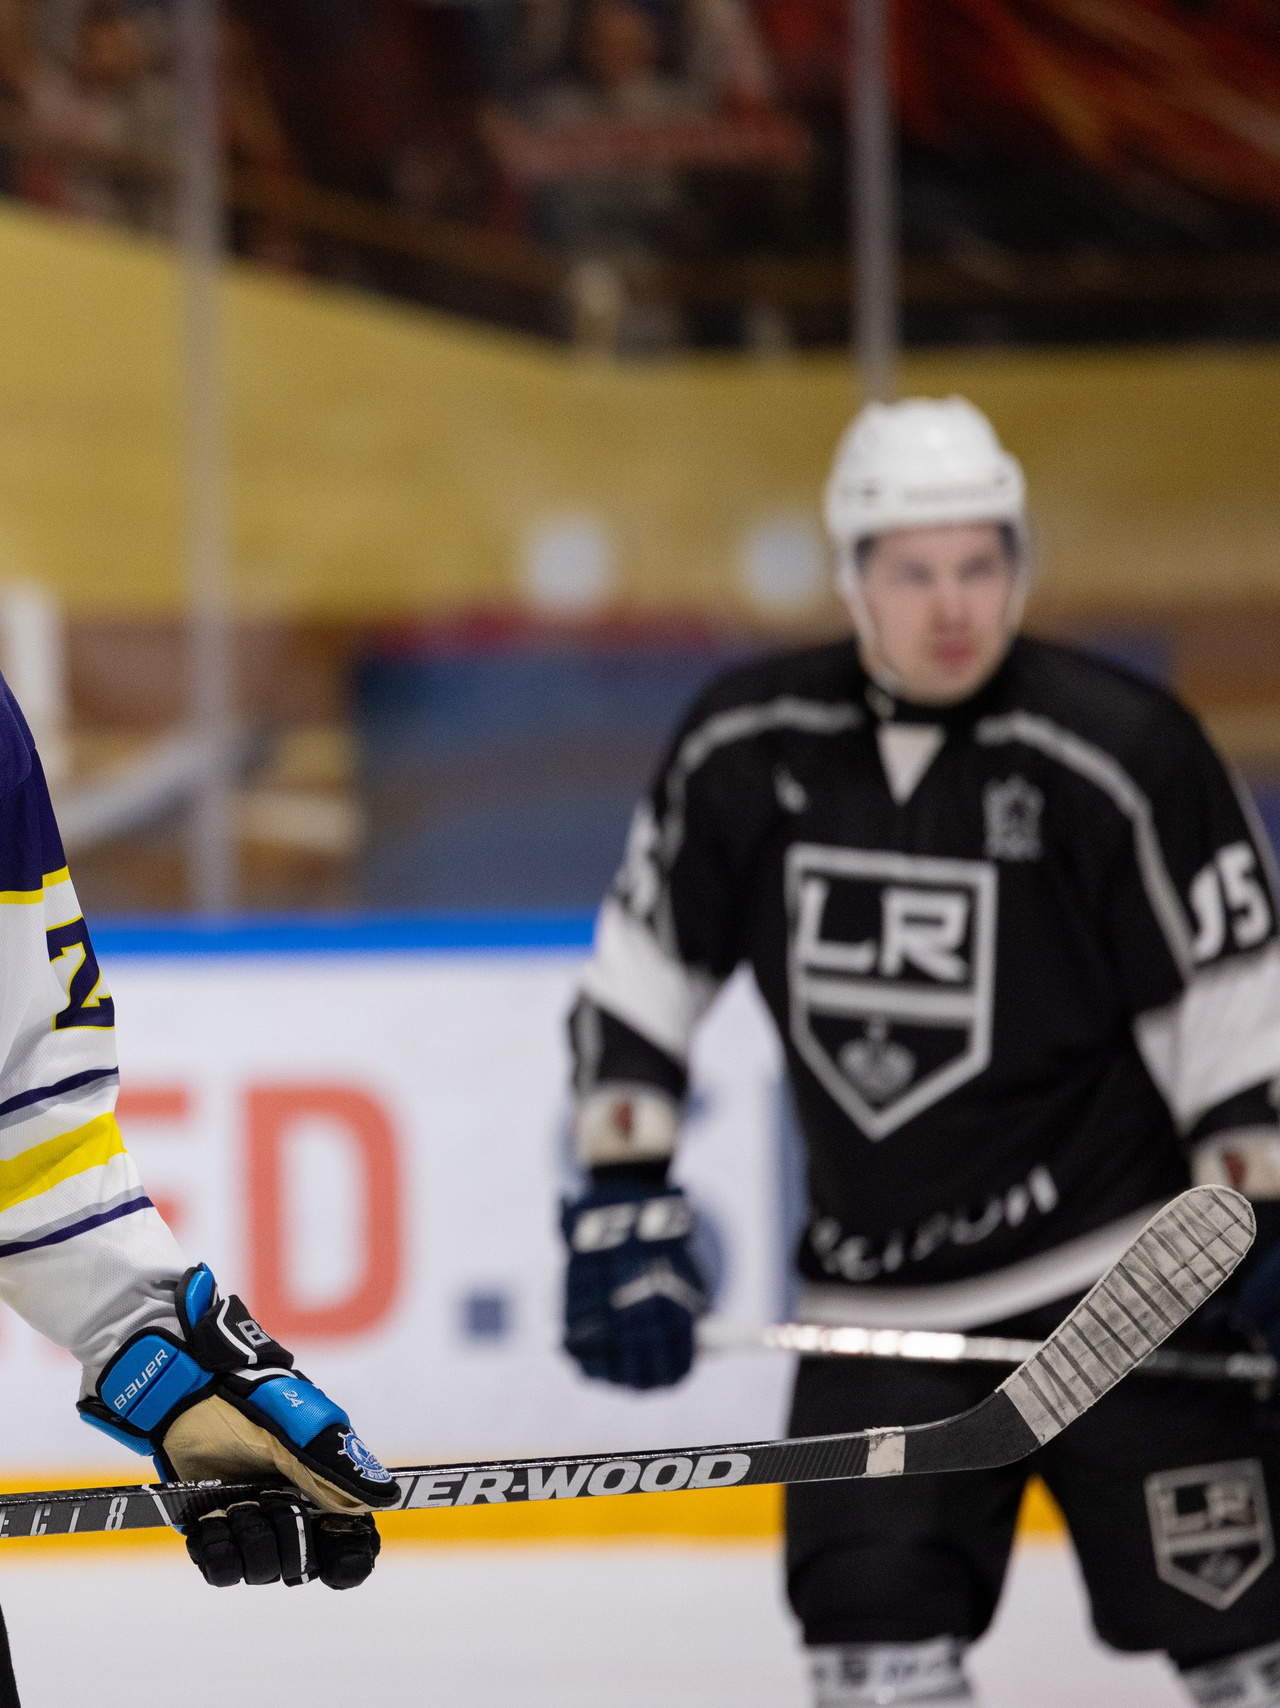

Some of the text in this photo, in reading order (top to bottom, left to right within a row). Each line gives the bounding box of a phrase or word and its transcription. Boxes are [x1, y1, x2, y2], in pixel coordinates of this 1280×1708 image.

[798, 880, 971, 982] LR
[46, 914, 115, 1031] 2
[113, 1348, 168, 1411] BAUER
[282, 1390, 305, 1408] 24
[104, 1496, 129, 1531] 8
